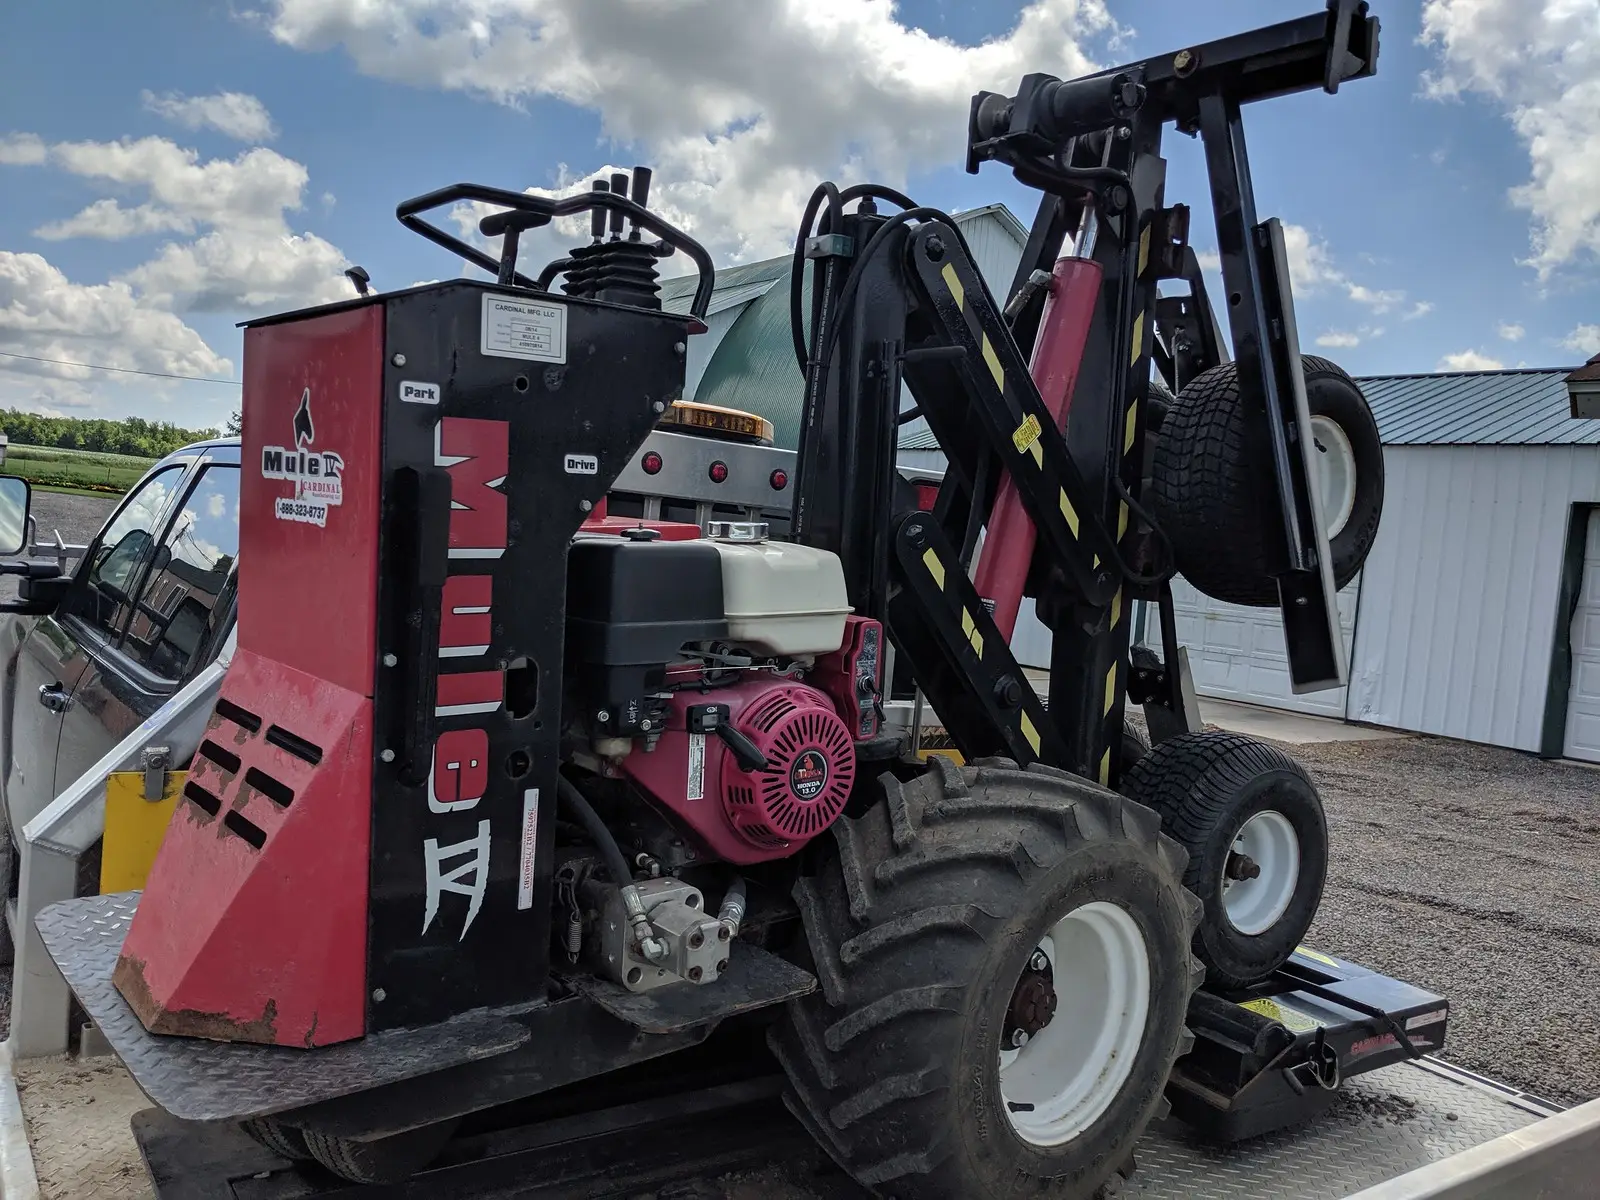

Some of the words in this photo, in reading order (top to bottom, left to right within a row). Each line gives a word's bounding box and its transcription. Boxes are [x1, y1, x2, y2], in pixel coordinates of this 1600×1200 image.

[495, 304, 526, 314] CARDINAL
[404, 386, 435, 400] Park
[263, 450, 320, 475] Mule
[322, 454, 342, 479] IV
[567, 459, 596, 470] Drive
[302, 481, 341, 494] CARDINAL
[427, 416, 510, 814] Mule
[797, 780, 821, 789] HONDA
[421, 819, 491, 942] IV
